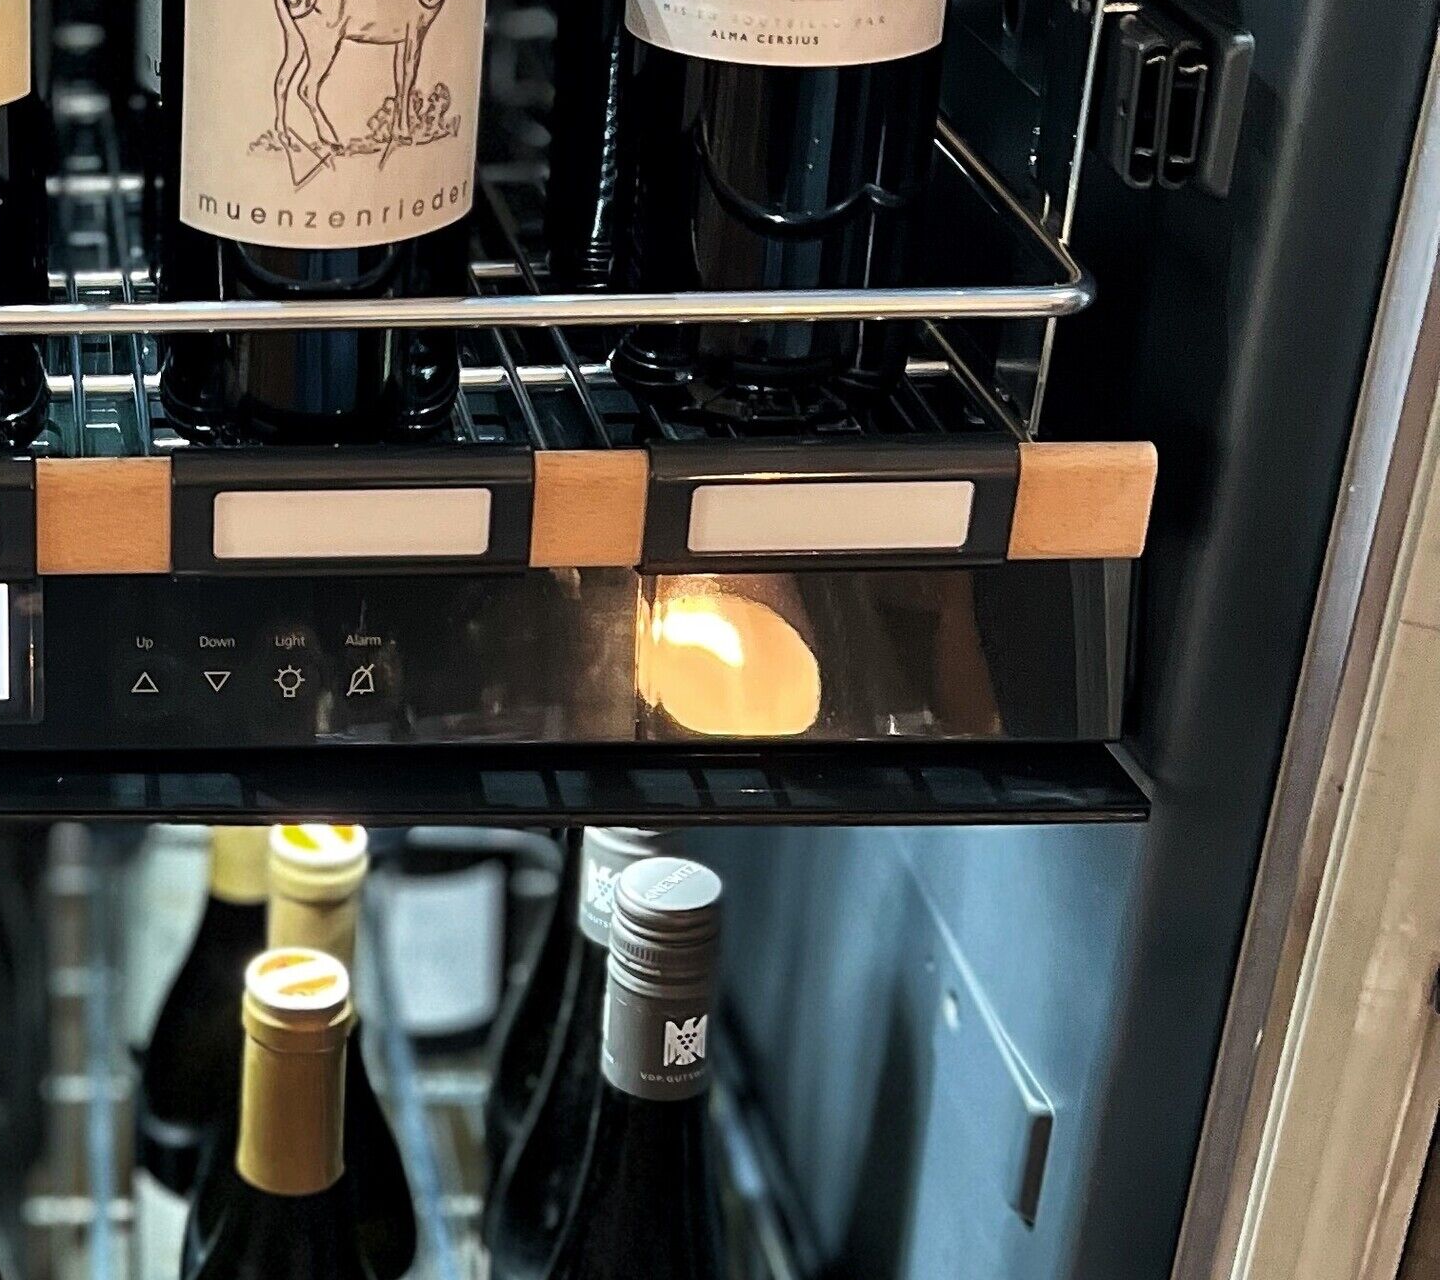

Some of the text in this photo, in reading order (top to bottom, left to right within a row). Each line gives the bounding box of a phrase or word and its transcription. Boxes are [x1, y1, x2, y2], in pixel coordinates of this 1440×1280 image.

[710, 29, 820, 46] ALMA CERSIUS
[198, 180, 468, 229] muenzenrieder
[136, 633, 382, 651] Up Down Light Alarm
